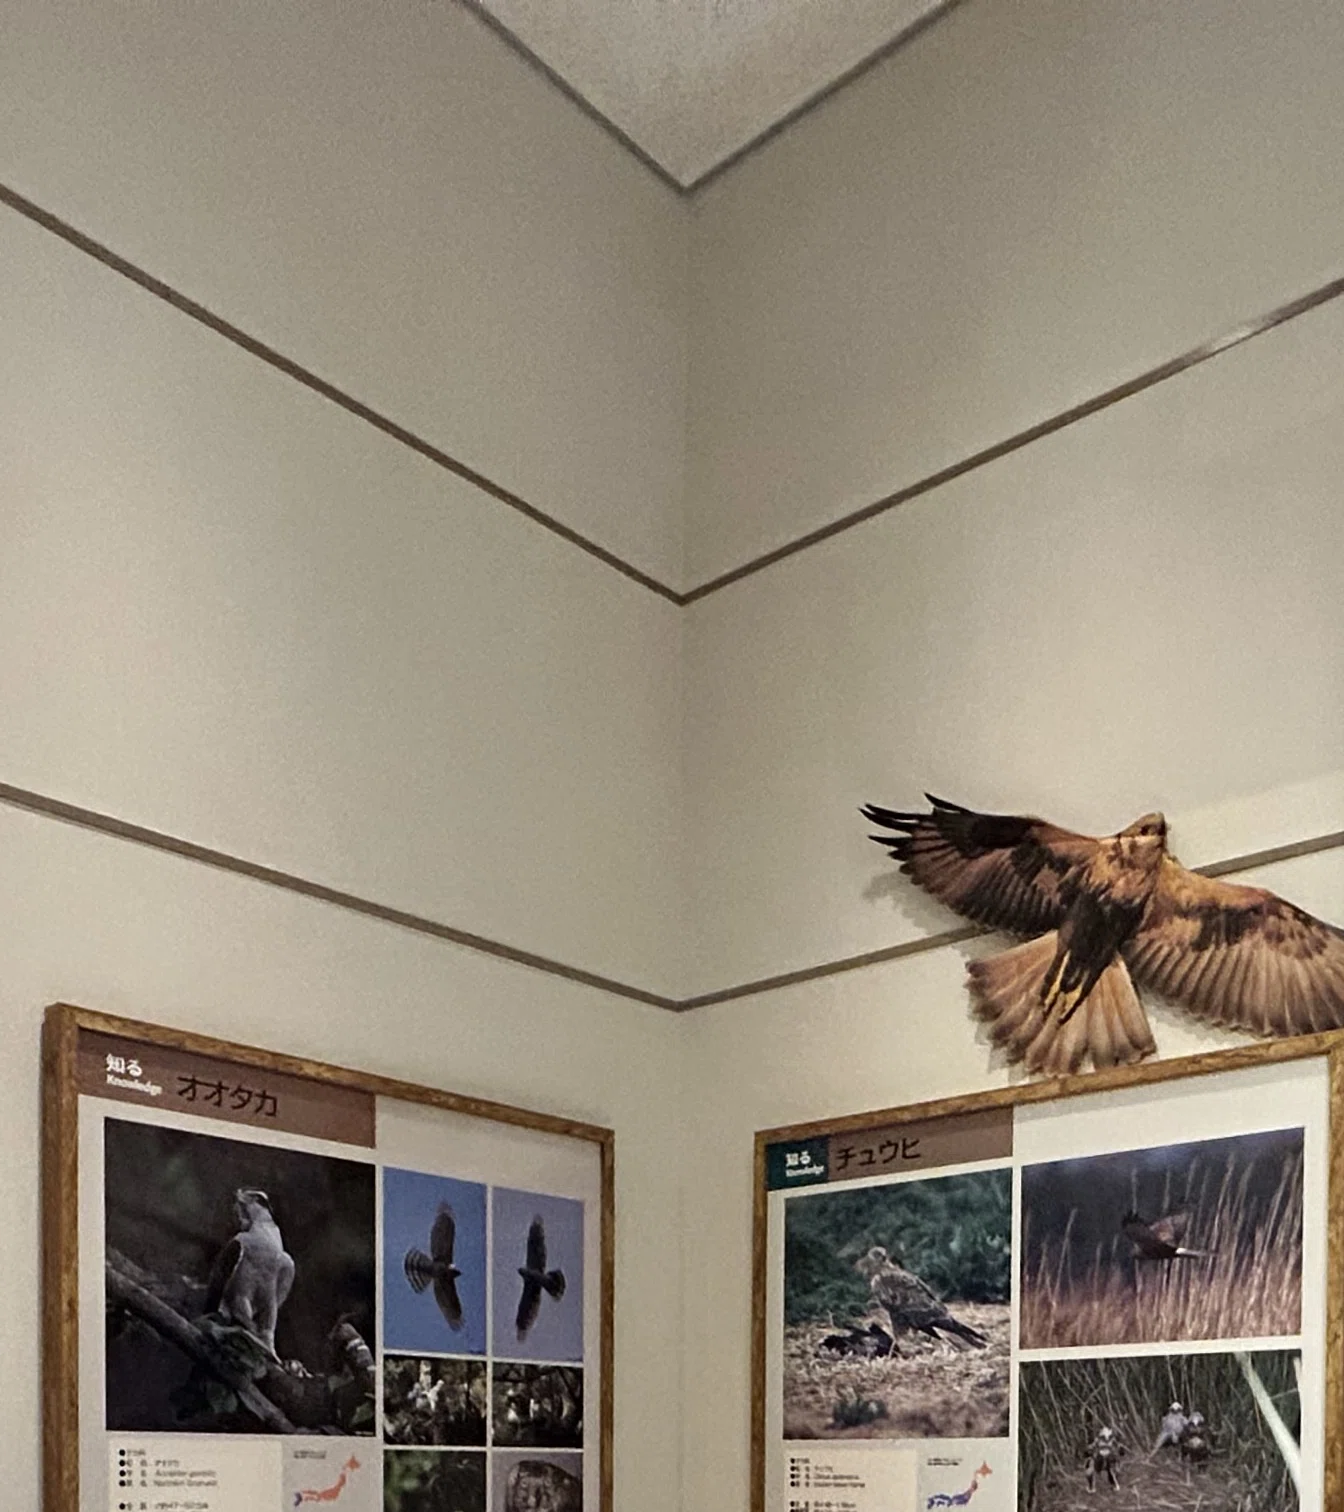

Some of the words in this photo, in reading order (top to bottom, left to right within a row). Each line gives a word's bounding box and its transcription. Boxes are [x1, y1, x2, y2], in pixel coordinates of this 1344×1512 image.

[105, 1053, 143, 1077] 知る
[107, 1074, 163, 1097] Knowledge
[177, 1073, 279, 1118] オオタカ
[836, 1137, 922, 1171] チュウヒ
